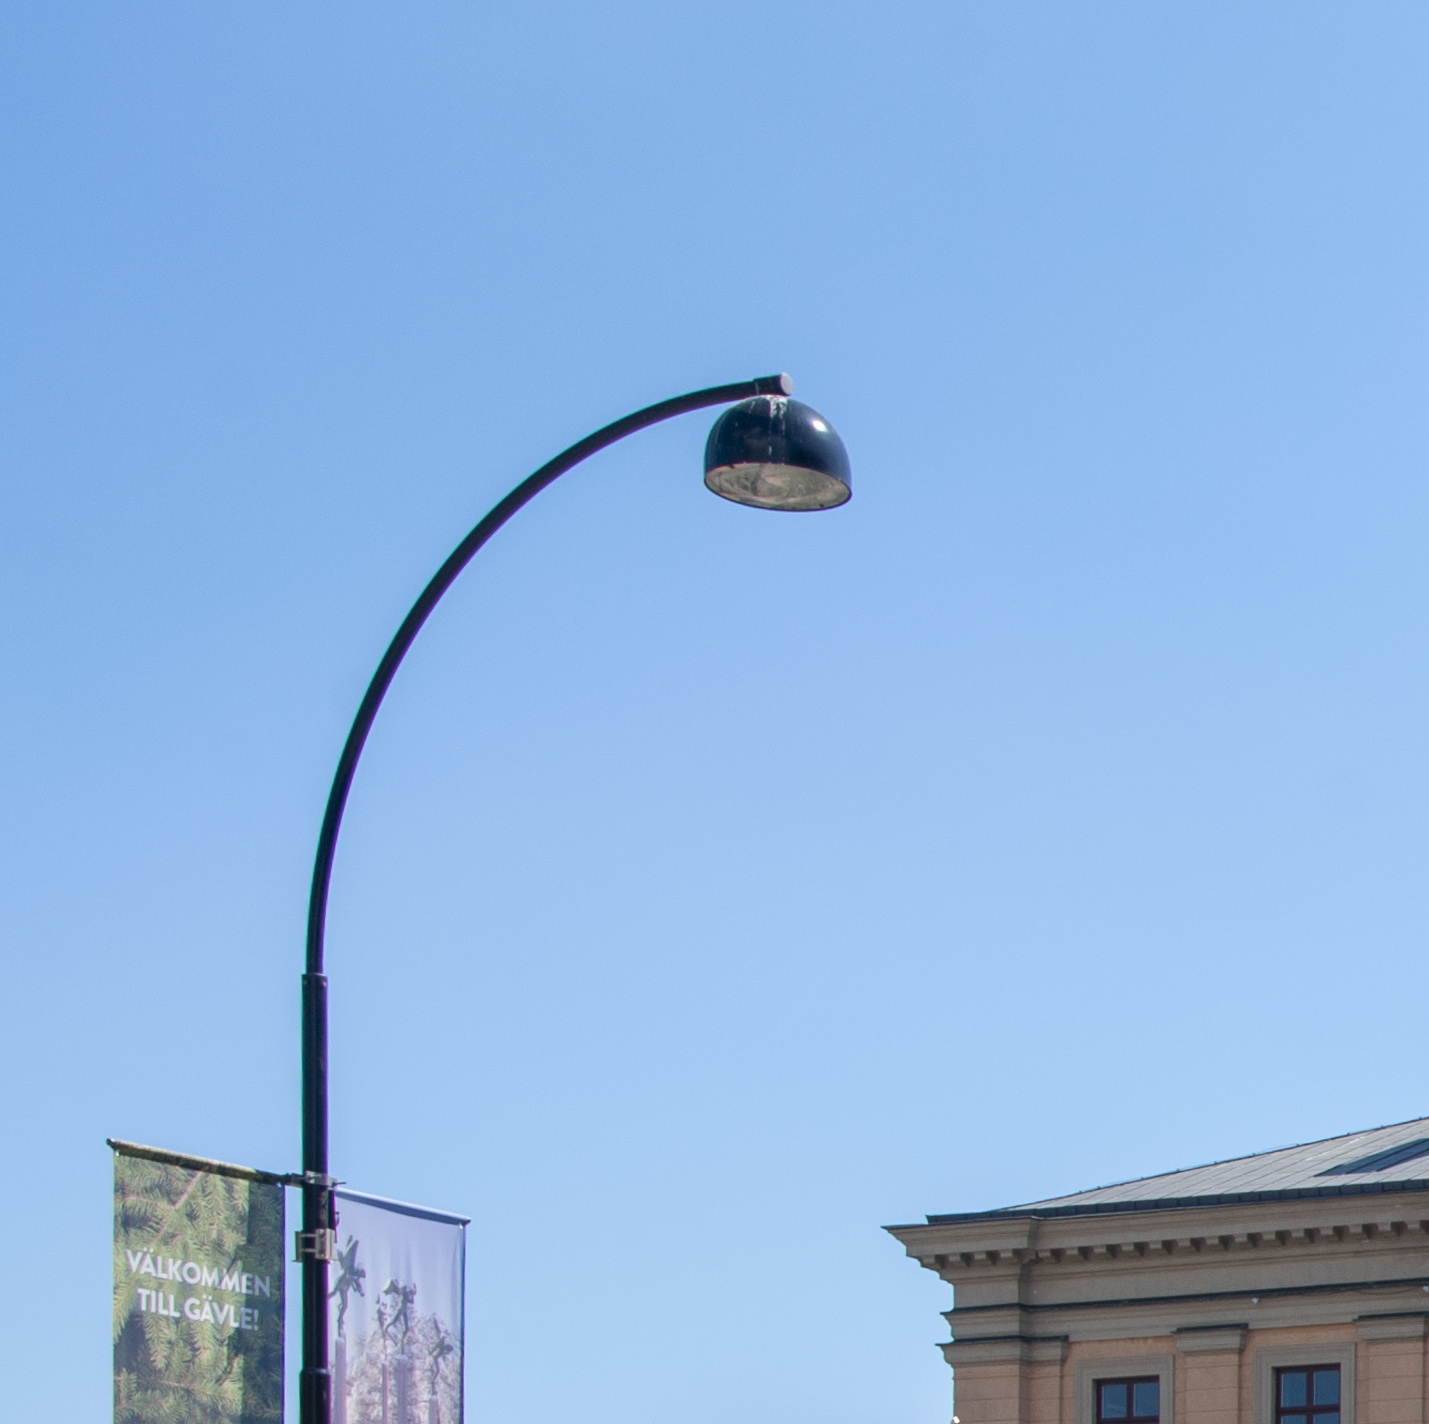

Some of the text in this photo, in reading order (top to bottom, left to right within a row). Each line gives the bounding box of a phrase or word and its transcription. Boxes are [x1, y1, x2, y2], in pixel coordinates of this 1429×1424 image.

[126, 1247, 271, 1298] VÄLKOMMEN
[137, 1288, 259, 1331] TILL GÄVLE!
